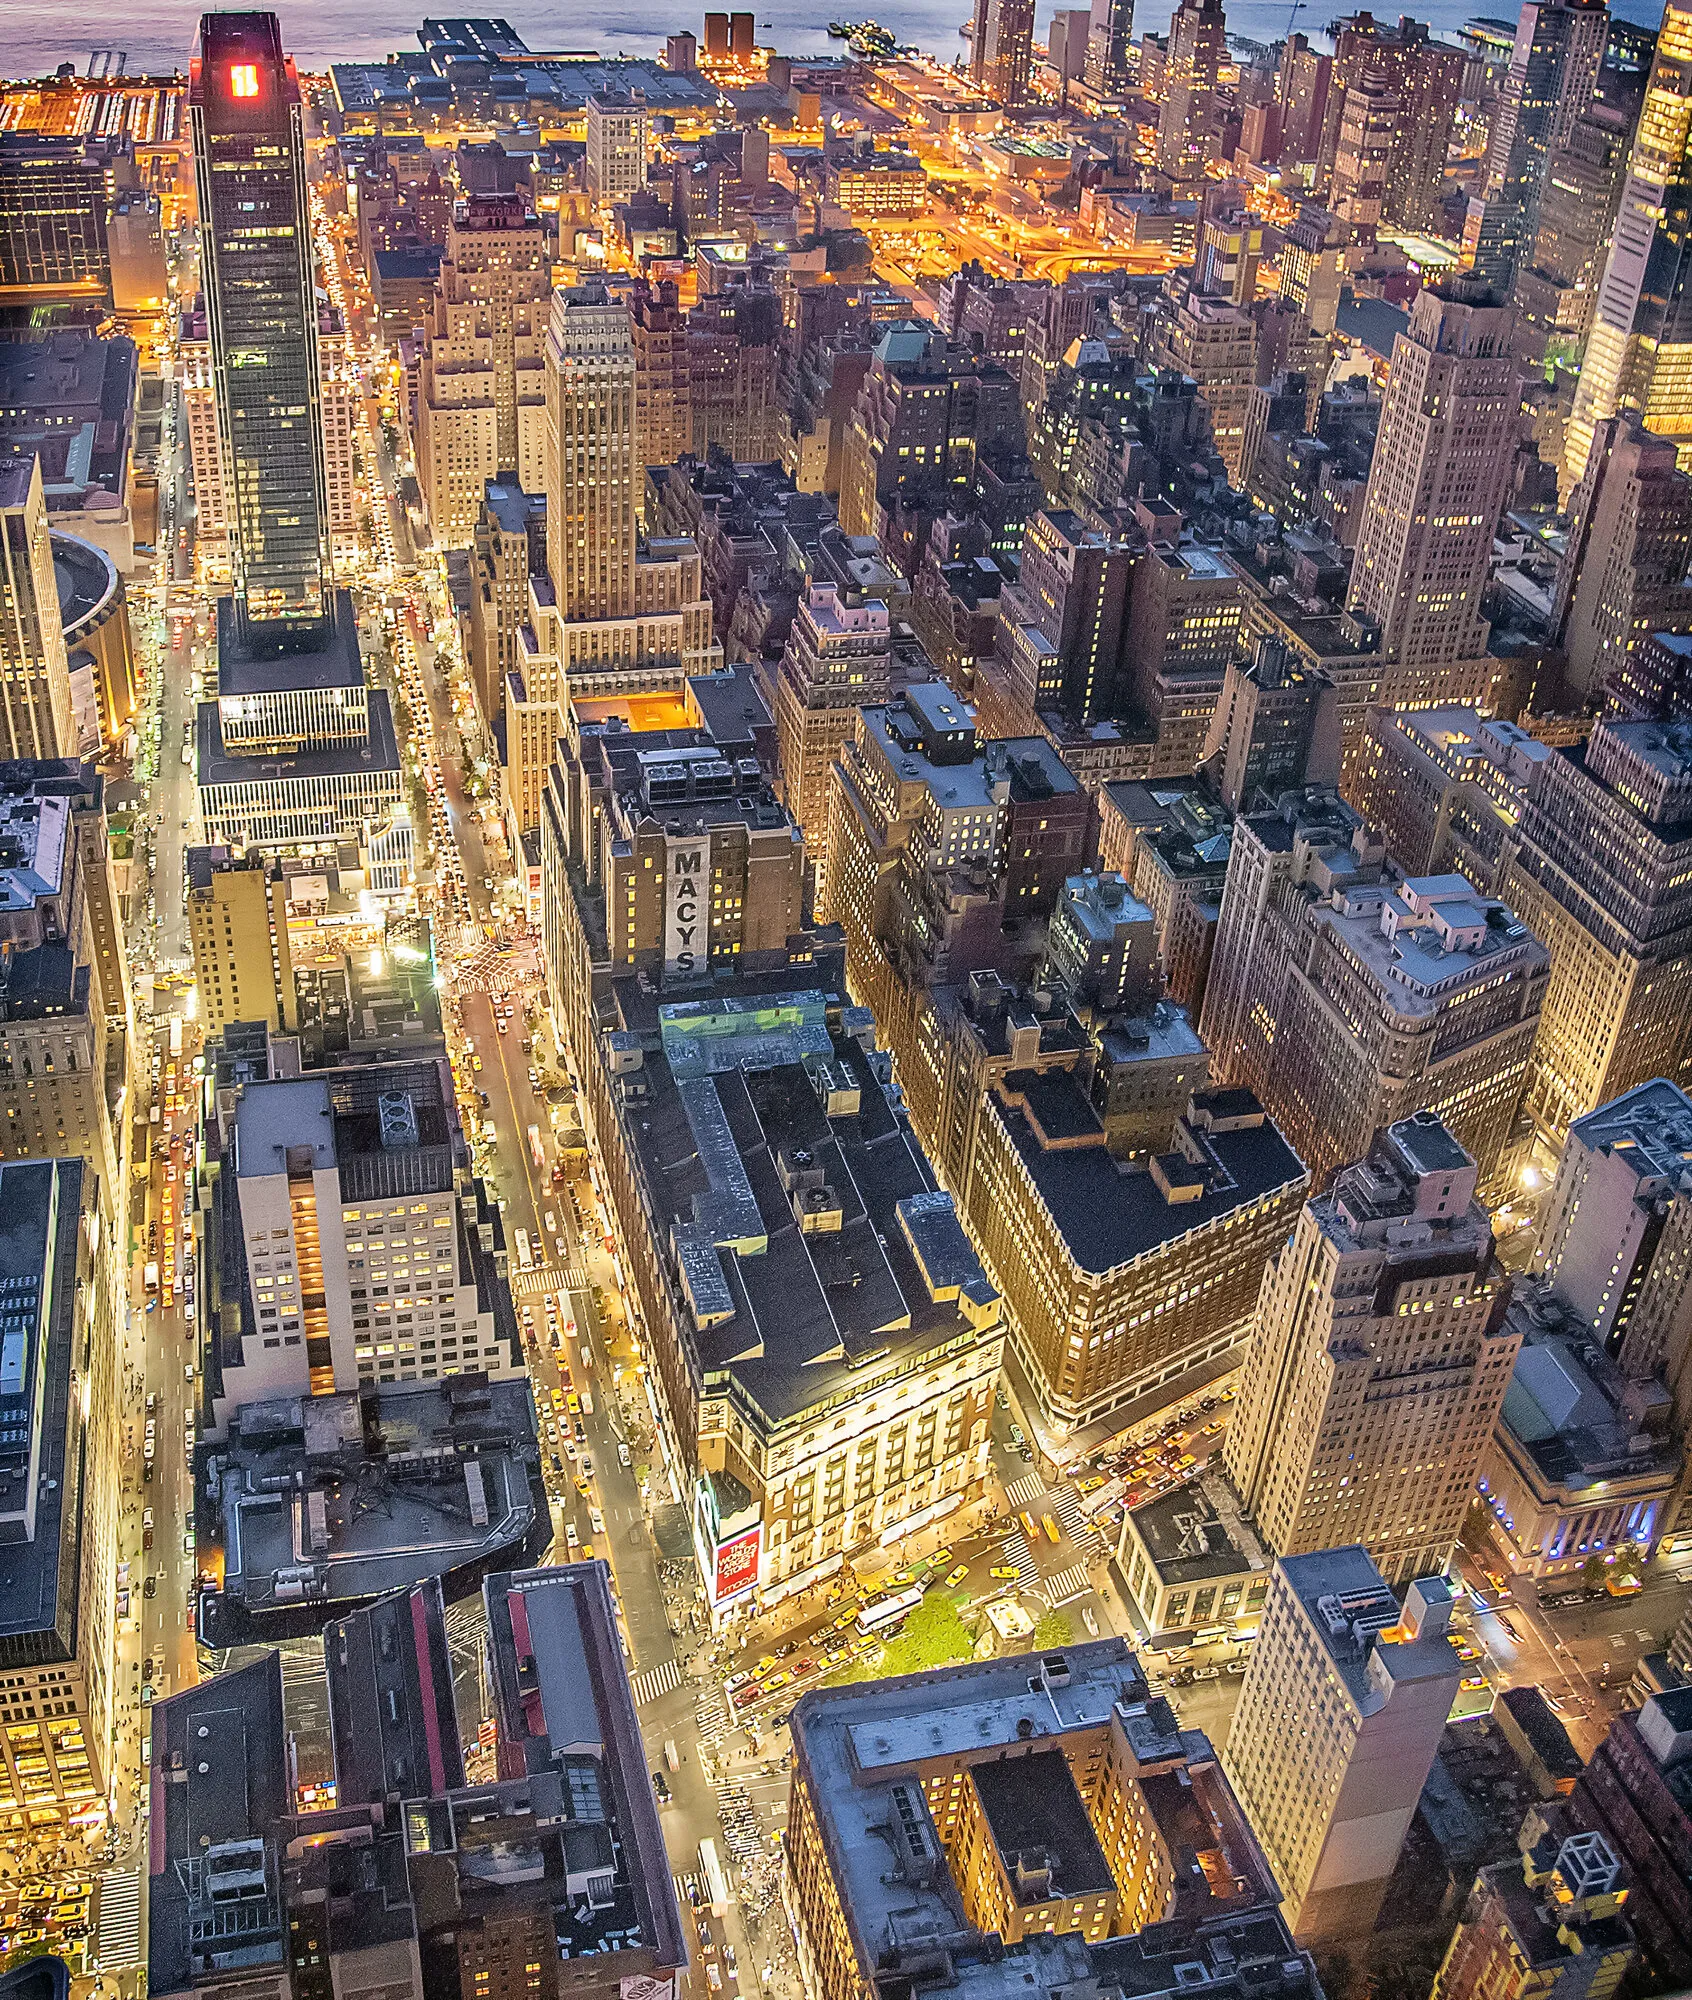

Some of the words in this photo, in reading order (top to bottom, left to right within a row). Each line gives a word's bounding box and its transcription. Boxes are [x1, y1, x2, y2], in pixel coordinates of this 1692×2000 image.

[463, 207, 485, 217] NEW
[489, 206, 532, 216] YORKER
[675, 851, 701, 972] MACYS
[730, 1540, 748, 1554] THE
[718, 1552, 755, 1574] LARGEST
[724, 1561, 751, 1579] STORE
